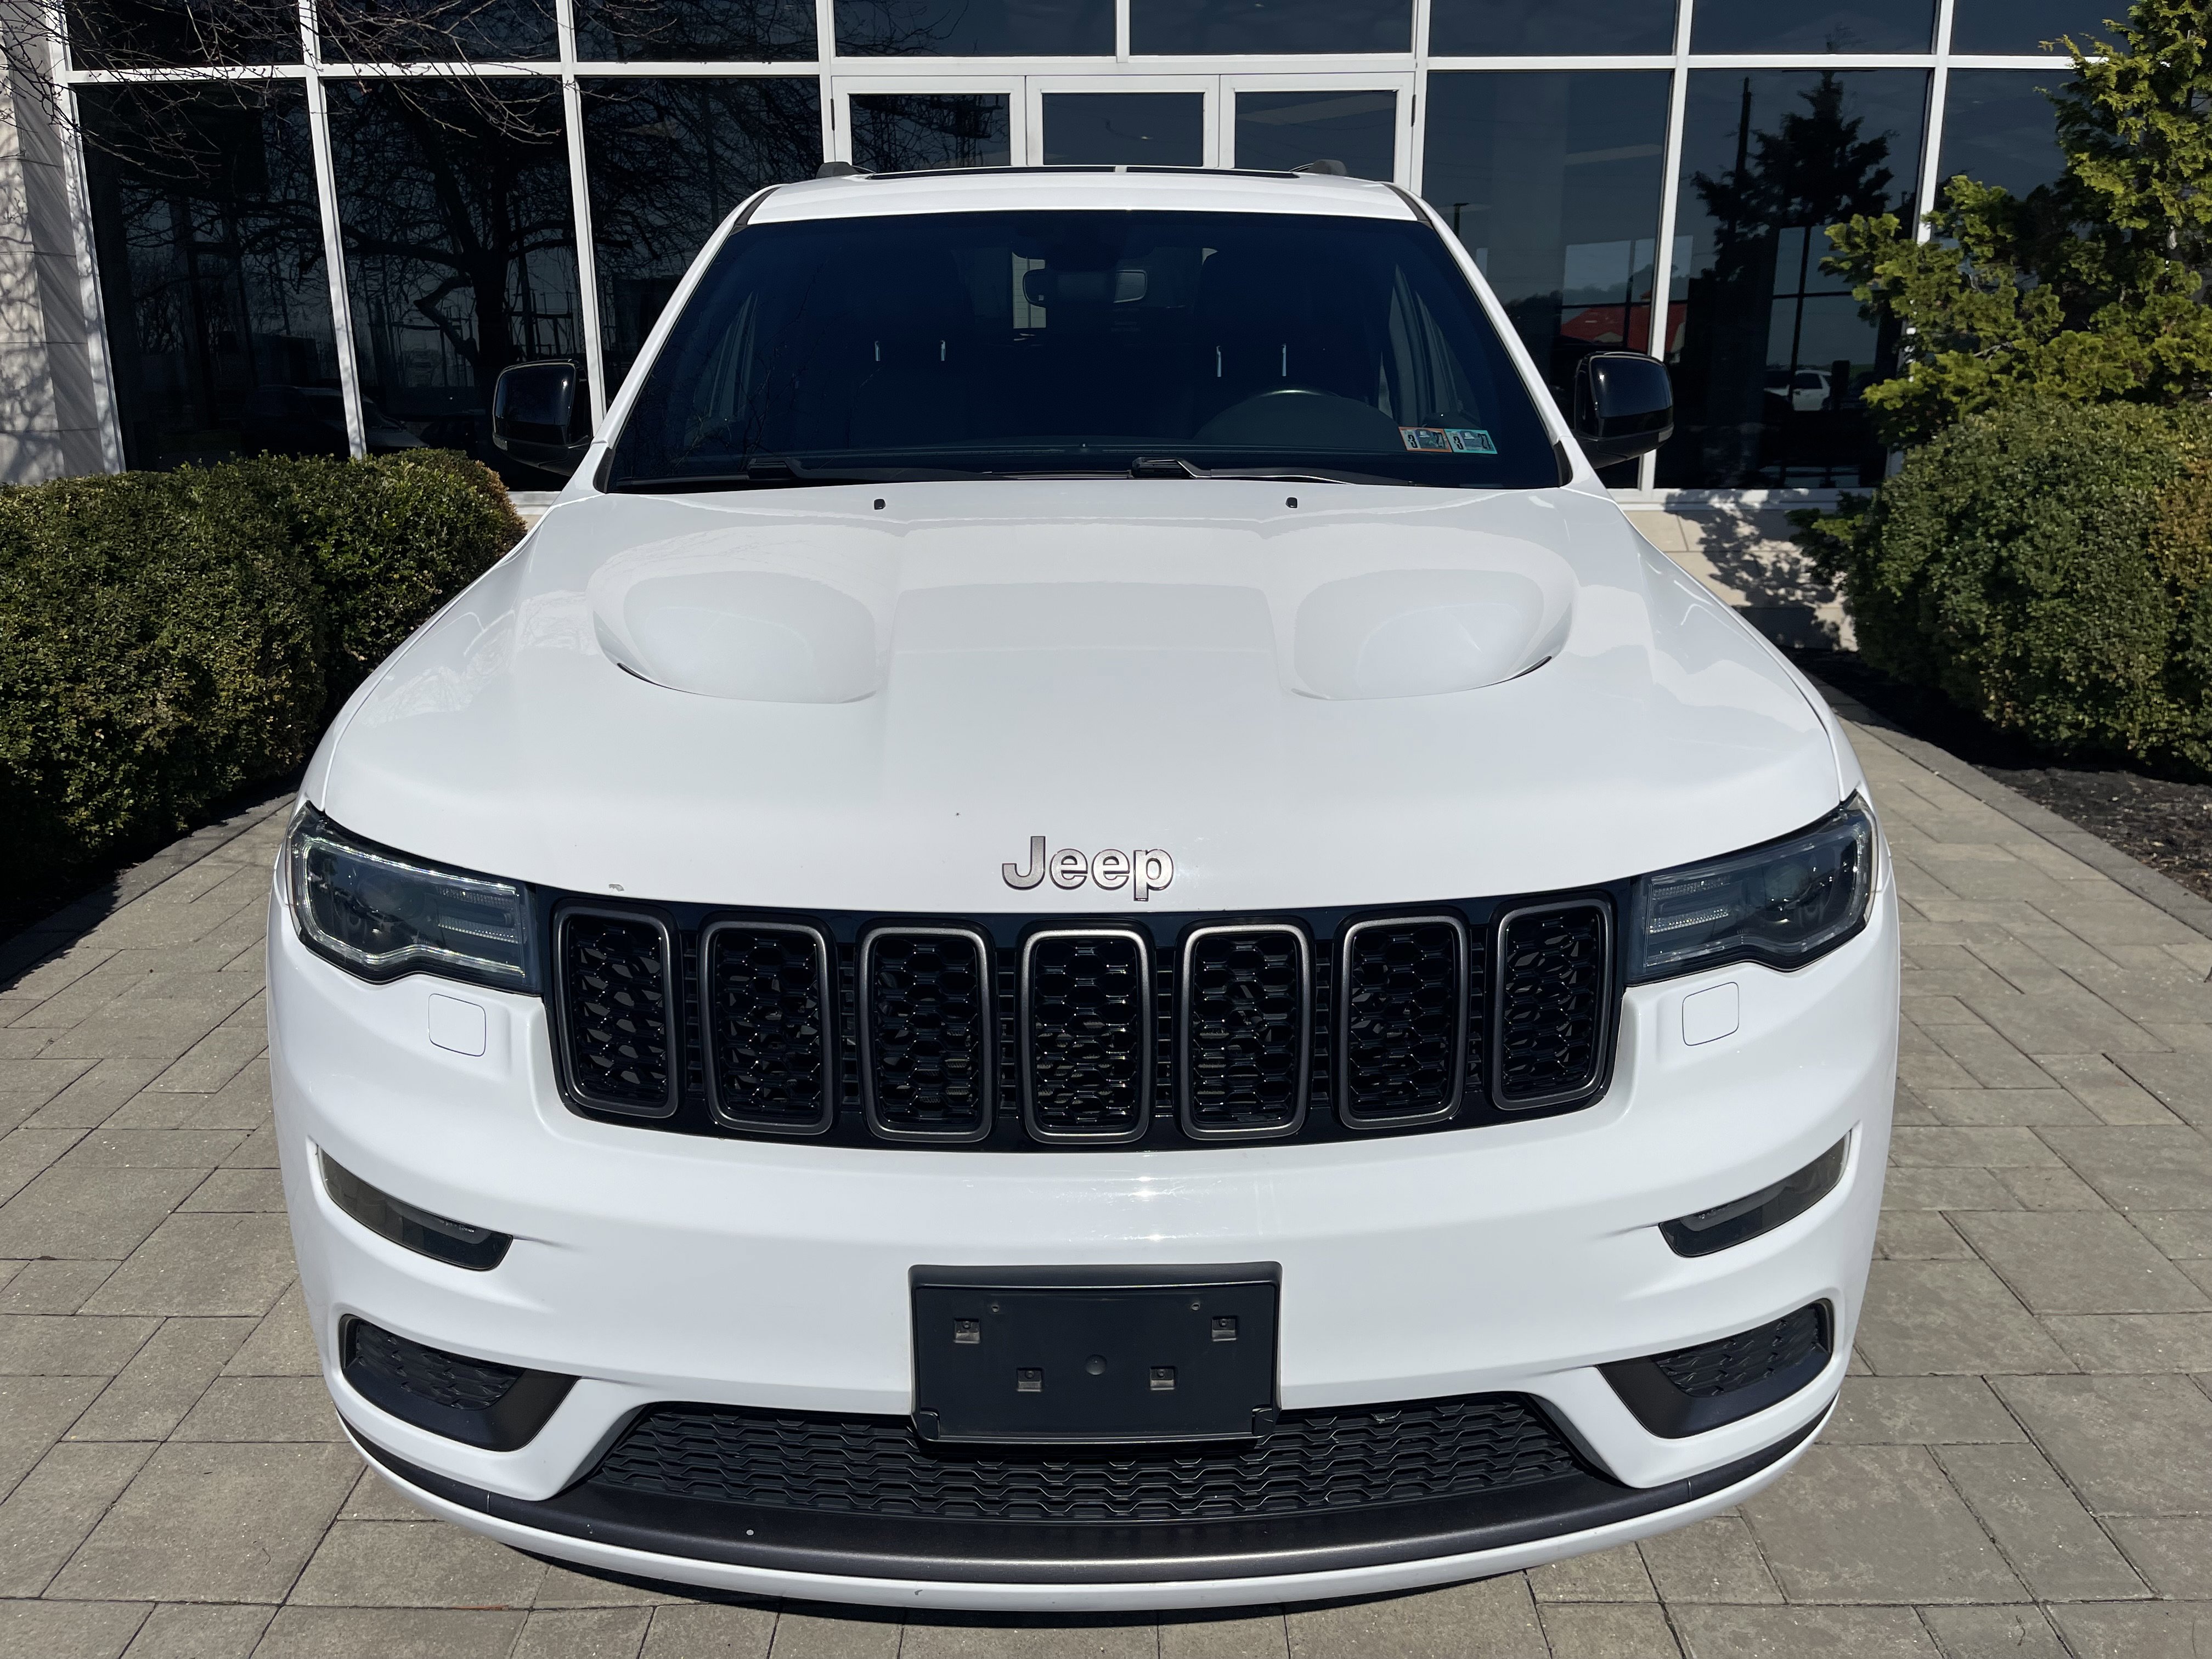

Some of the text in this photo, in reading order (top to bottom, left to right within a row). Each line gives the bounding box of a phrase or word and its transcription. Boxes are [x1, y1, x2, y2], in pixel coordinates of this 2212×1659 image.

[1408, 435, 1418, 448] 3
[1453, 436, 1464, 450] 3
[1002, 836, 1173, 901] Jeep
